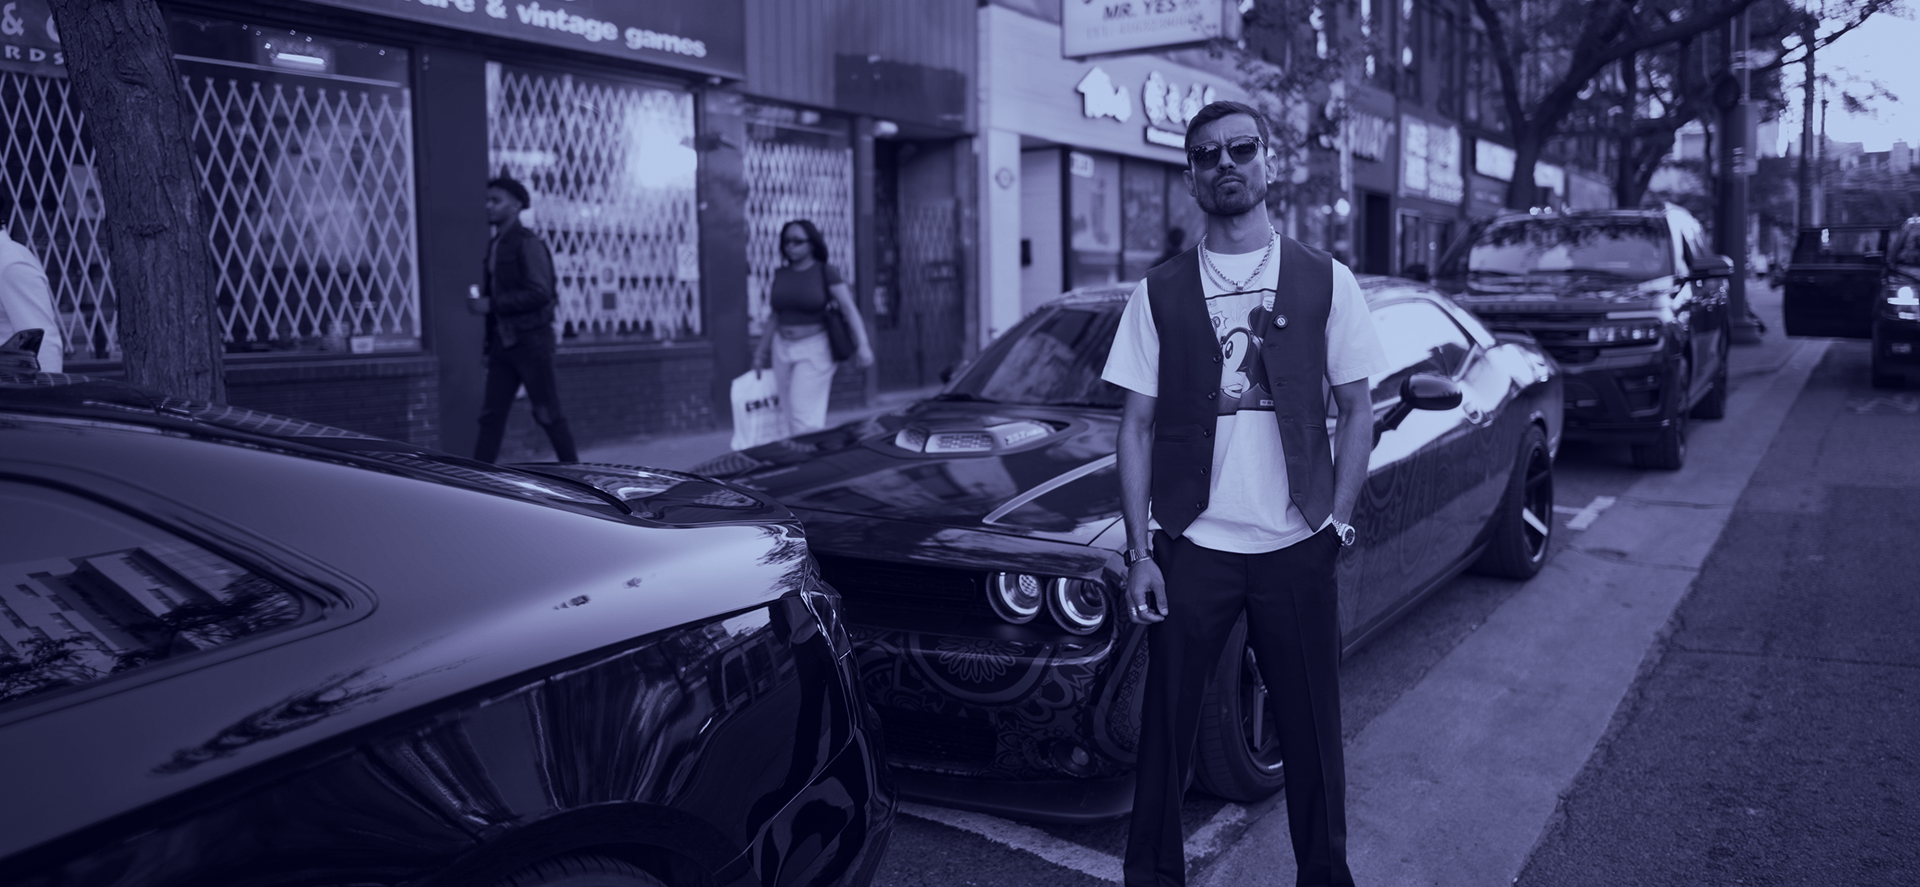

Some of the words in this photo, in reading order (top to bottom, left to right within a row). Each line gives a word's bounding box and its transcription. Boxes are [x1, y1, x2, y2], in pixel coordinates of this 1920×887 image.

[1, 2, 25, 36] &
[1103, 2, 1136, 20] MR.
[1143, 0, 1177, 14] YES
[484, 0, 507, 19] &
[516, 1, 618, 42] vintage
[624, 27, 707, 57] games
